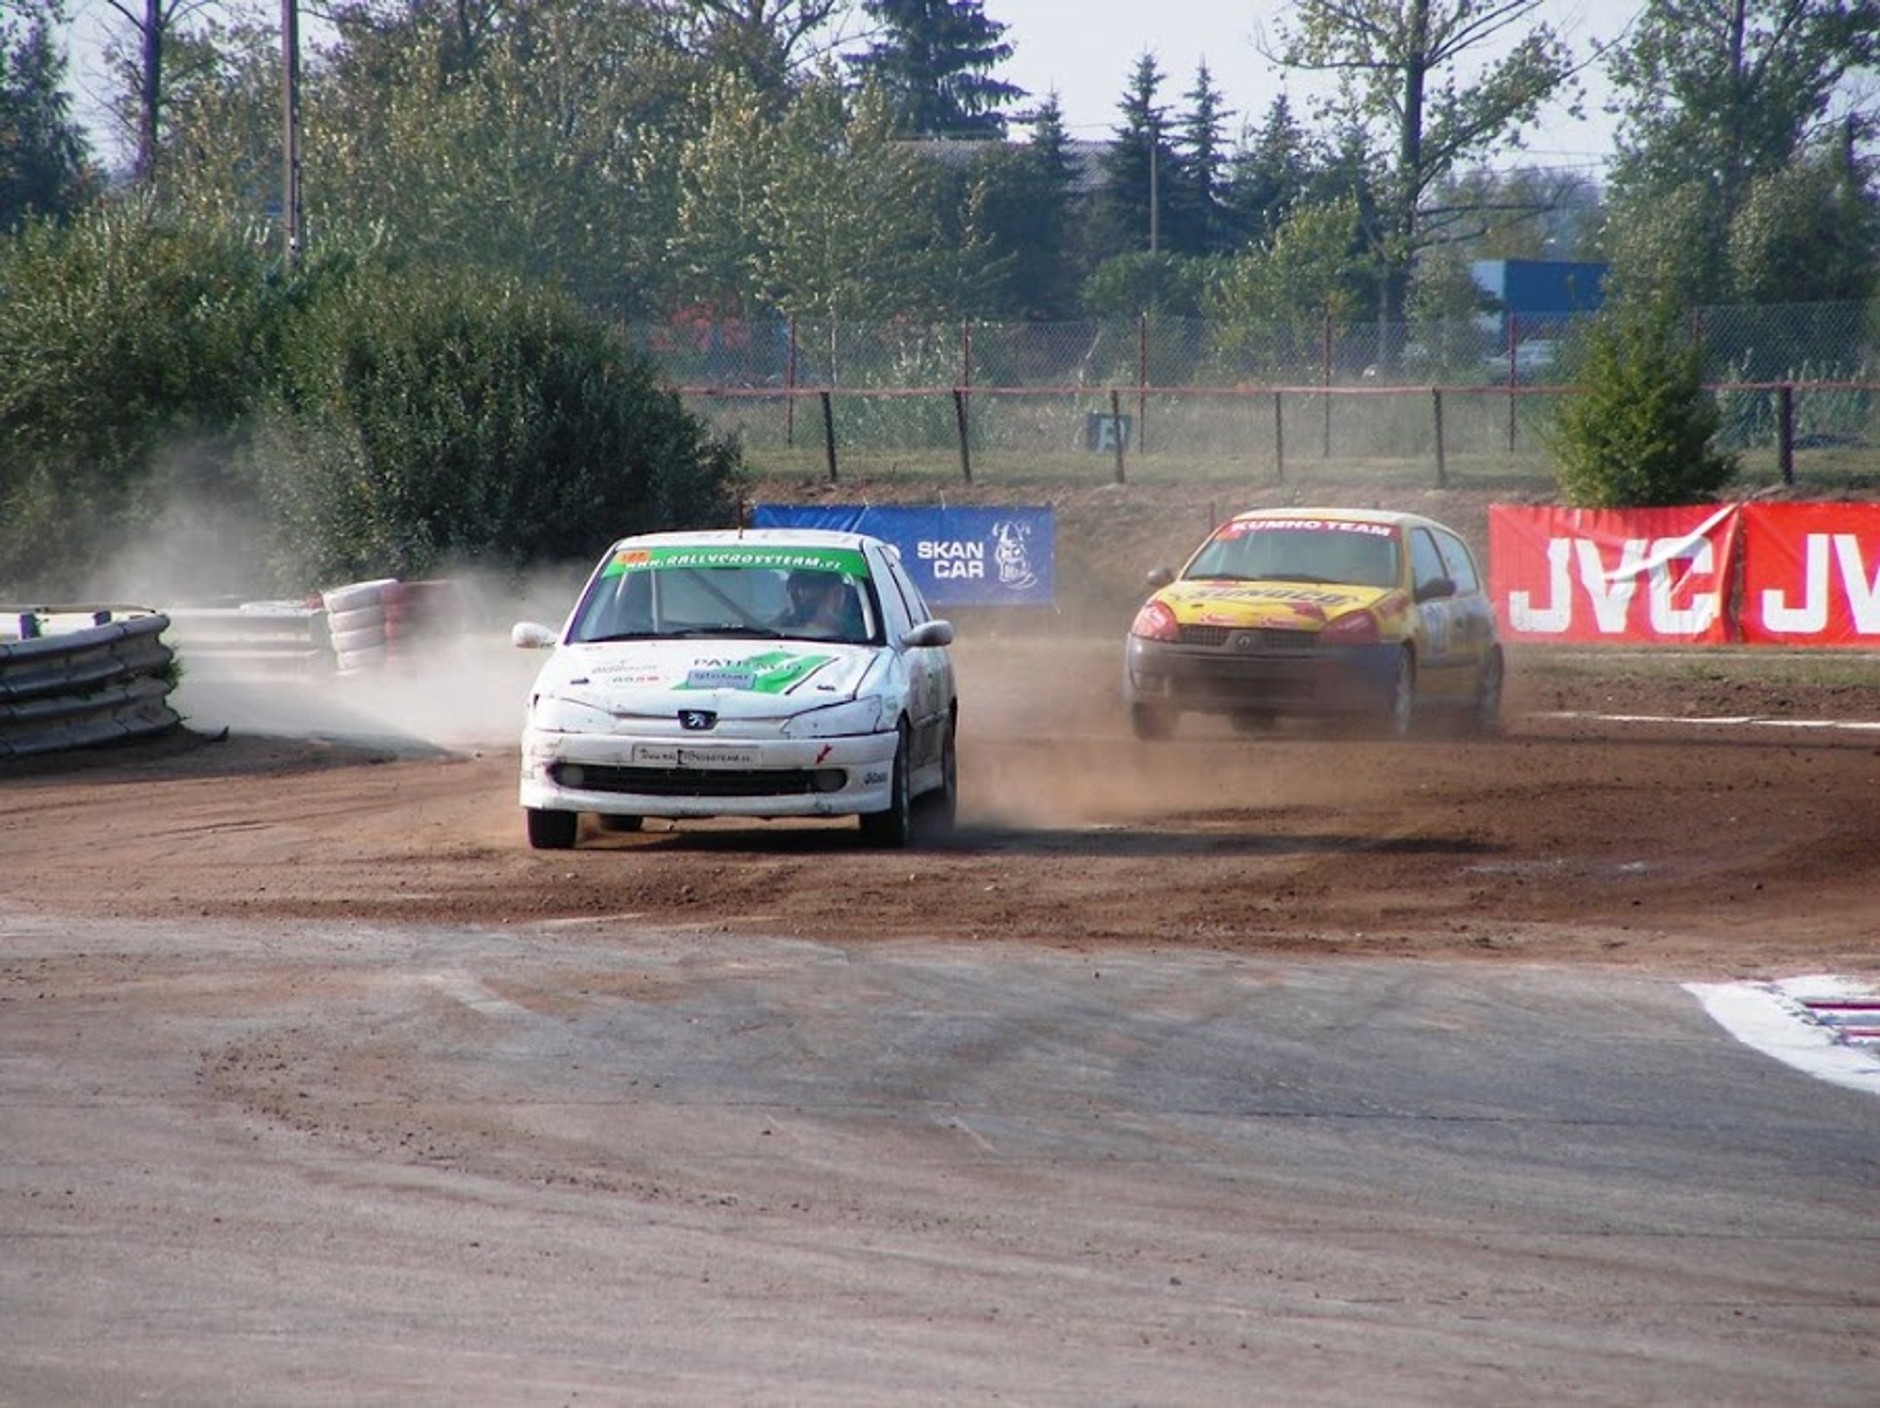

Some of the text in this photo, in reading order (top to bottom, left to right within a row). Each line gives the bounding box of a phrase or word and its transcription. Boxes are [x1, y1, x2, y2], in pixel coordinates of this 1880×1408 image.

[1231, 520, 1391, 537] KUMHO TEAM
[917, 541, 984, 559] SKAN
[933, 560, 985, 579] CAR
[1508, 536, 1723, 634] JVC
